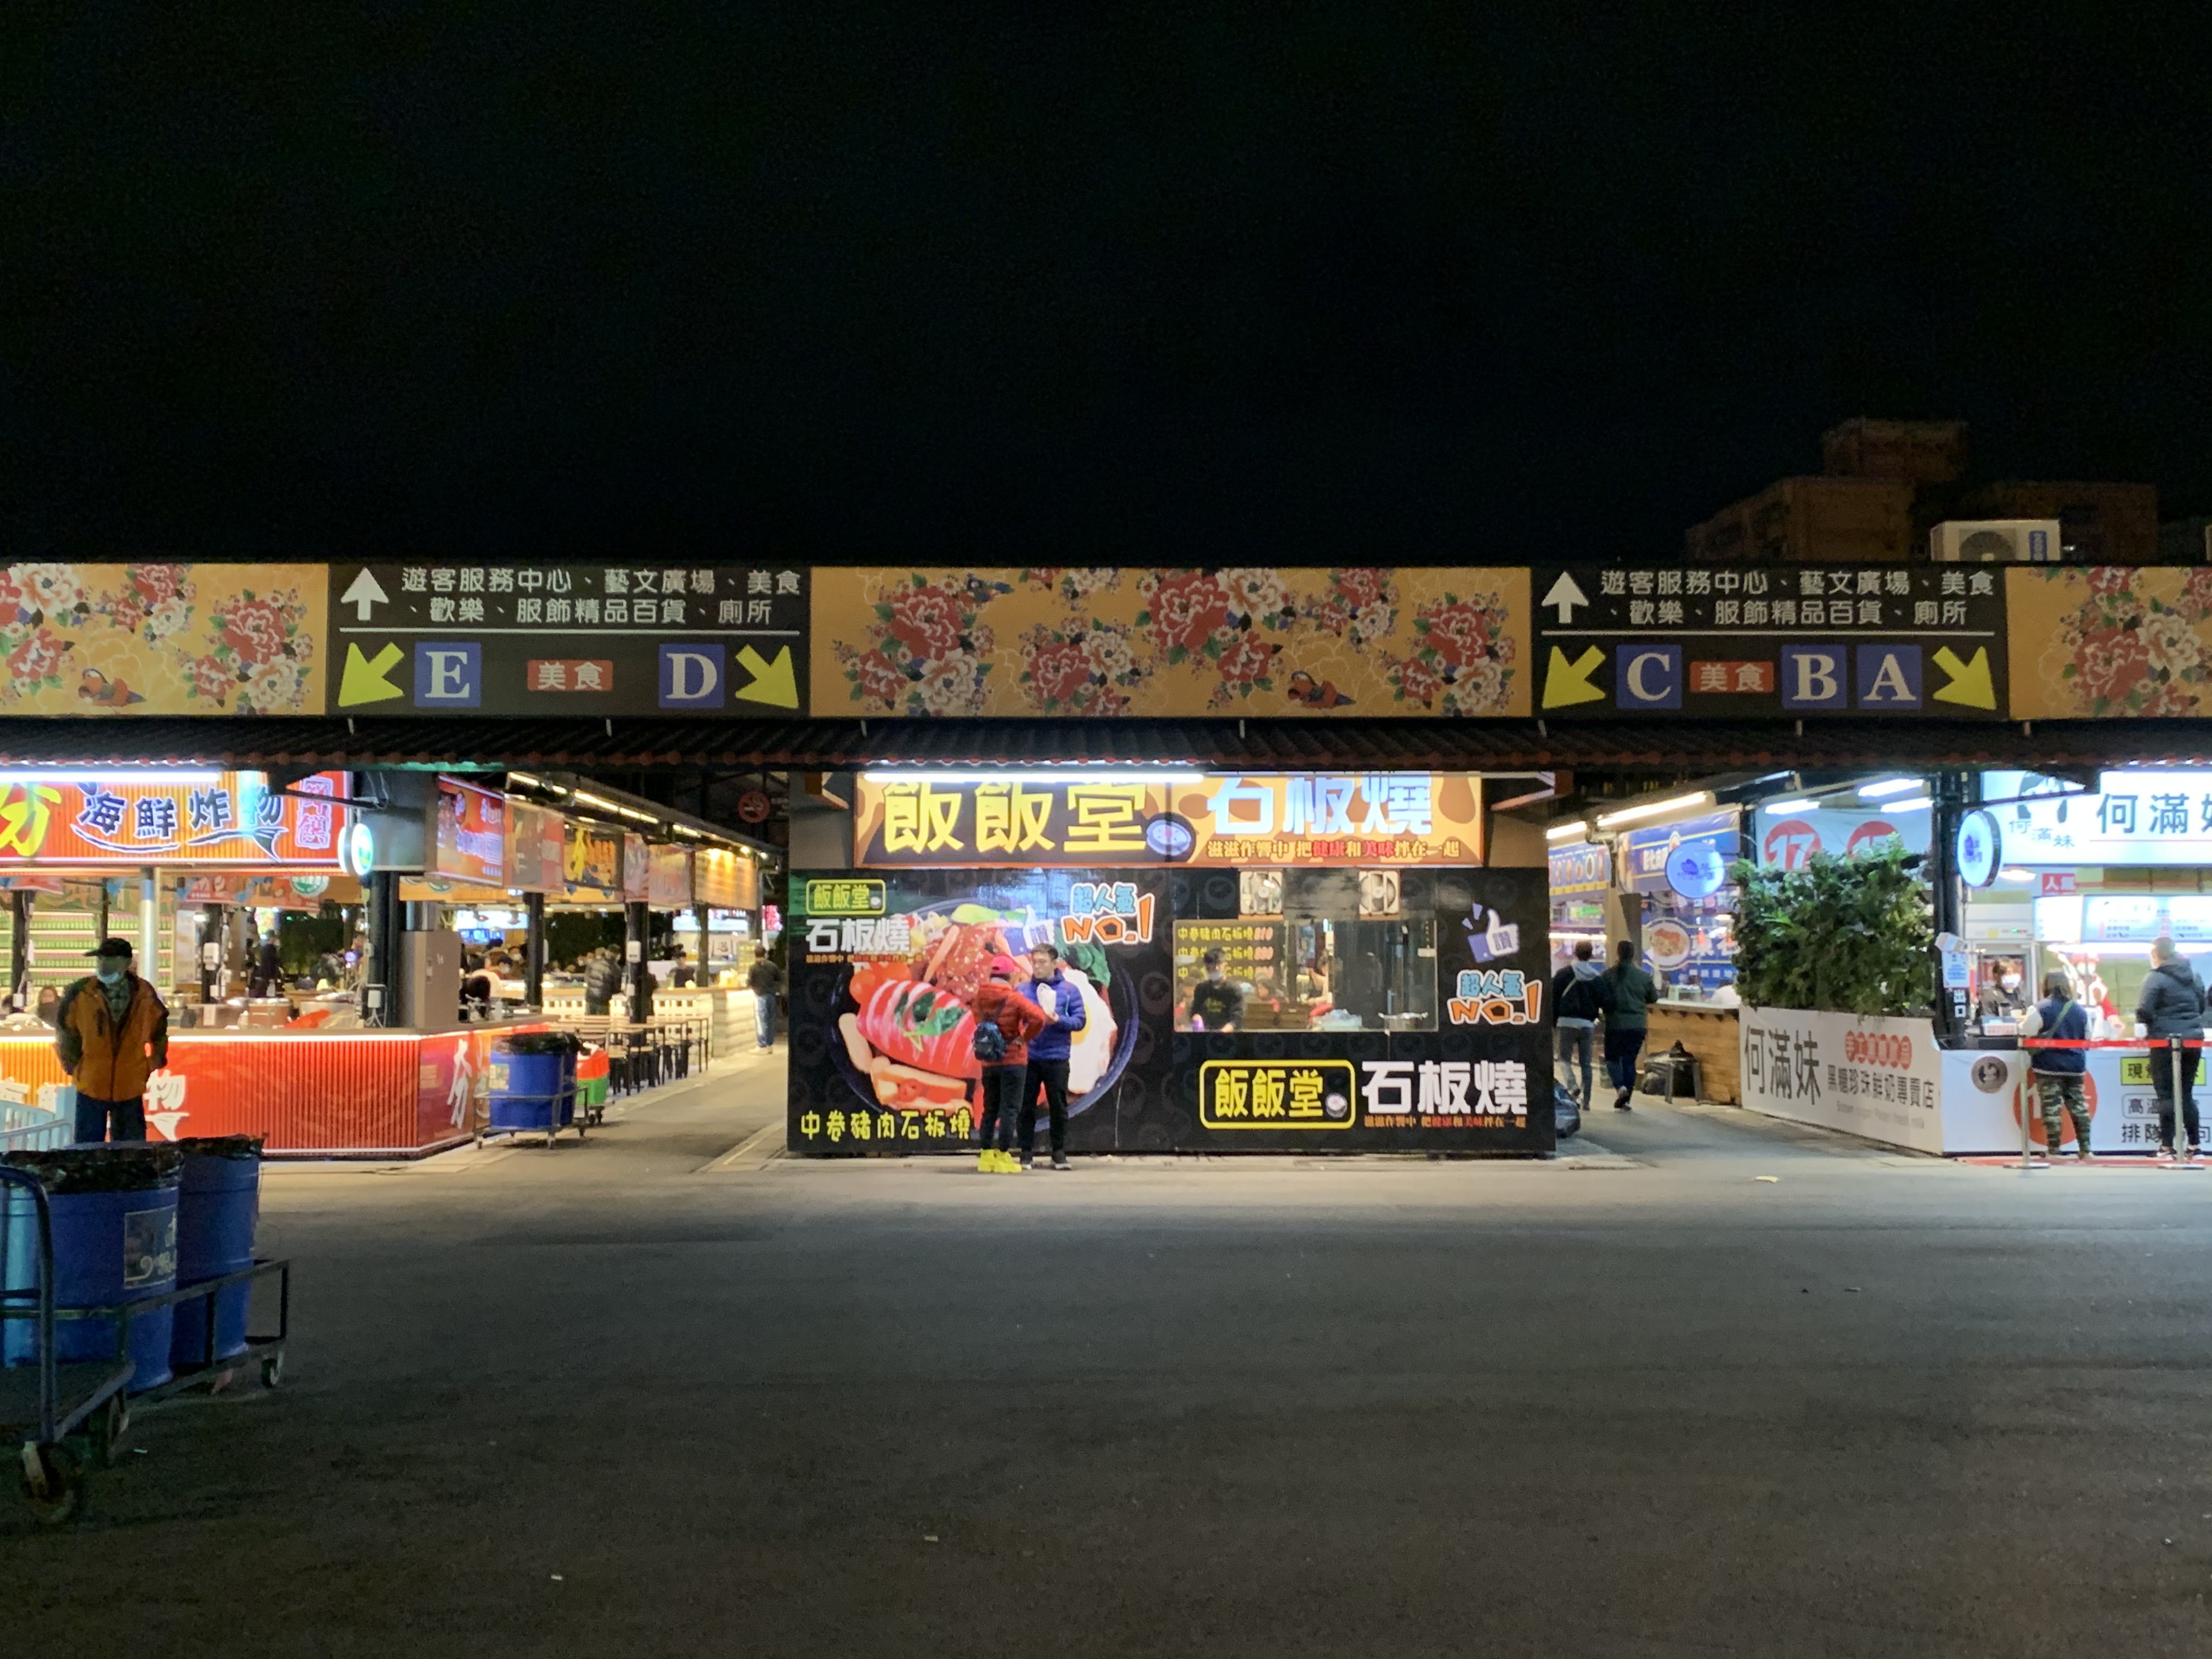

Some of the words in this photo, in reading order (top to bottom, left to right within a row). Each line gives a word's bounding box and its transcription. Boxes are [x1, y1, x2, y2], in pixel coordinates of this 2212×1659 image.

[425, 651, 470, 698] E
[537, 662, 603, 691] 美食
[665, 653, 718, 699] D
[1627, 653, 1671, 701] C
[1699, 663, 1764, 692] 美食
[1792, 654, 1838, 701] B
[1863, 653, 1917, 701] A
[76, 785, 284, 839] 海鮮炸物
[883, 781, 1147, 855] 飯飯堂
[1207, 772, 1432, 835] 石板燒
[1768, 833, 1815, 870] 17
[814, 884, 870, 909] 飯飯堂
[805, 917, 910, 952] 石板燒
[1214, 1069, 1324, 1119] 飯飯堂
[1362, 1059, 1528, 1115] 石板燒
[1745, 1024, 1821, 1105] 何滿妹
